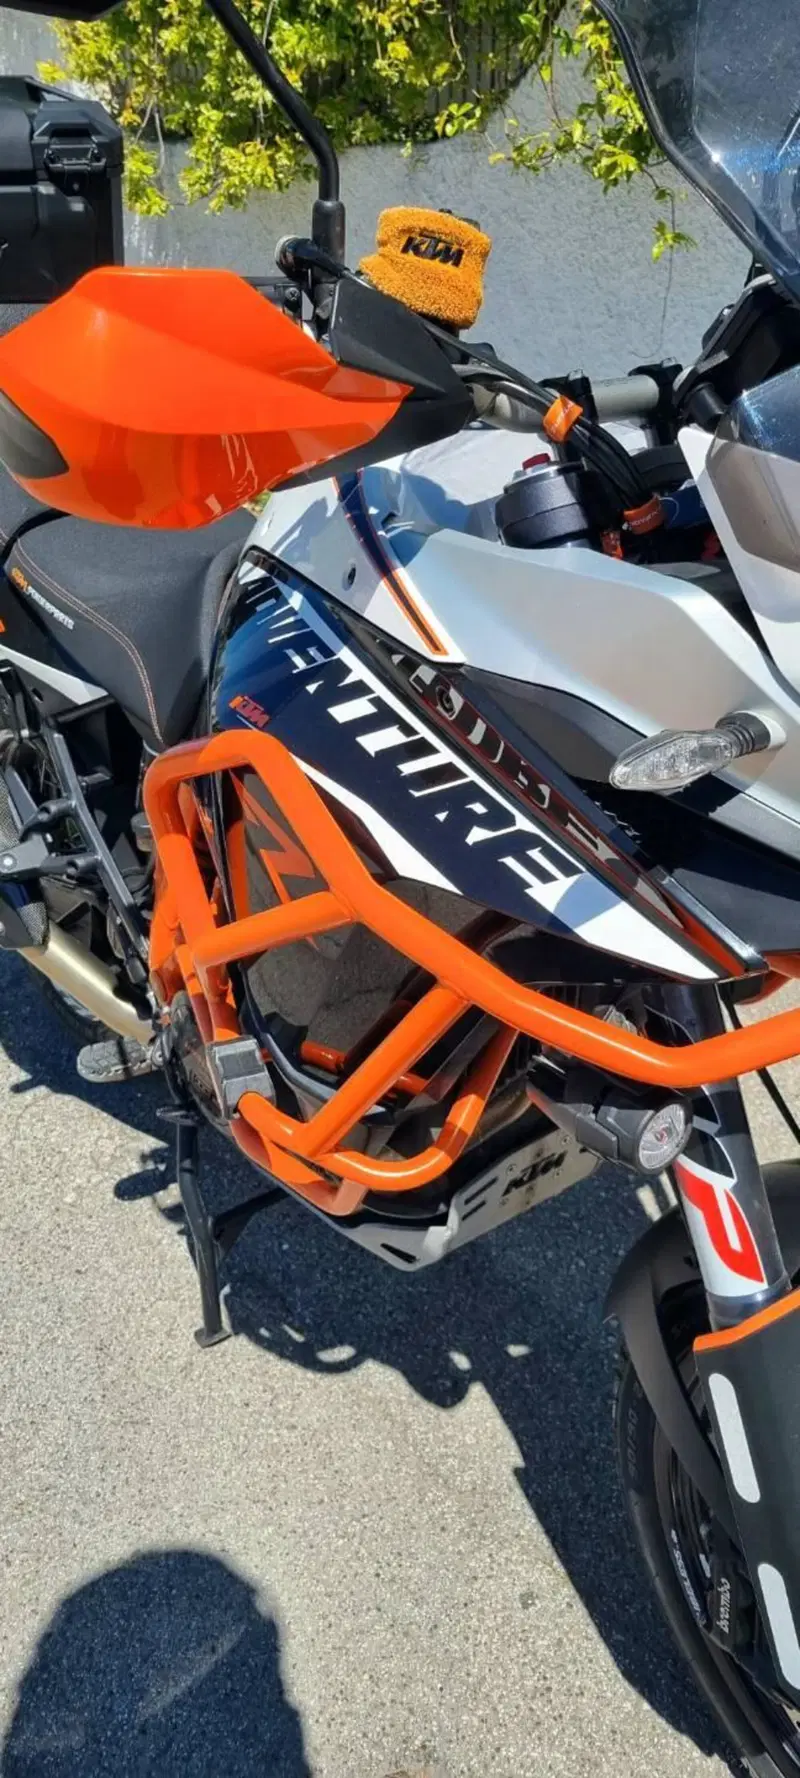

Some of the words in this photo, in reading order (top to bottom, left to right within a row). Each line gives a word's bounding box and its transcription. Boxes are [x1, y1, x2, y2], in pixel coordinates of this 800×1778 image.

[401, 231, 464, 268] KTM
[229, 695, 270, 728] KTM
[240, 570, 583, 893] ADVENTURE
[501, 1150, 567, 1197] KTM
[716, 1577, 731, 1634] brembo
